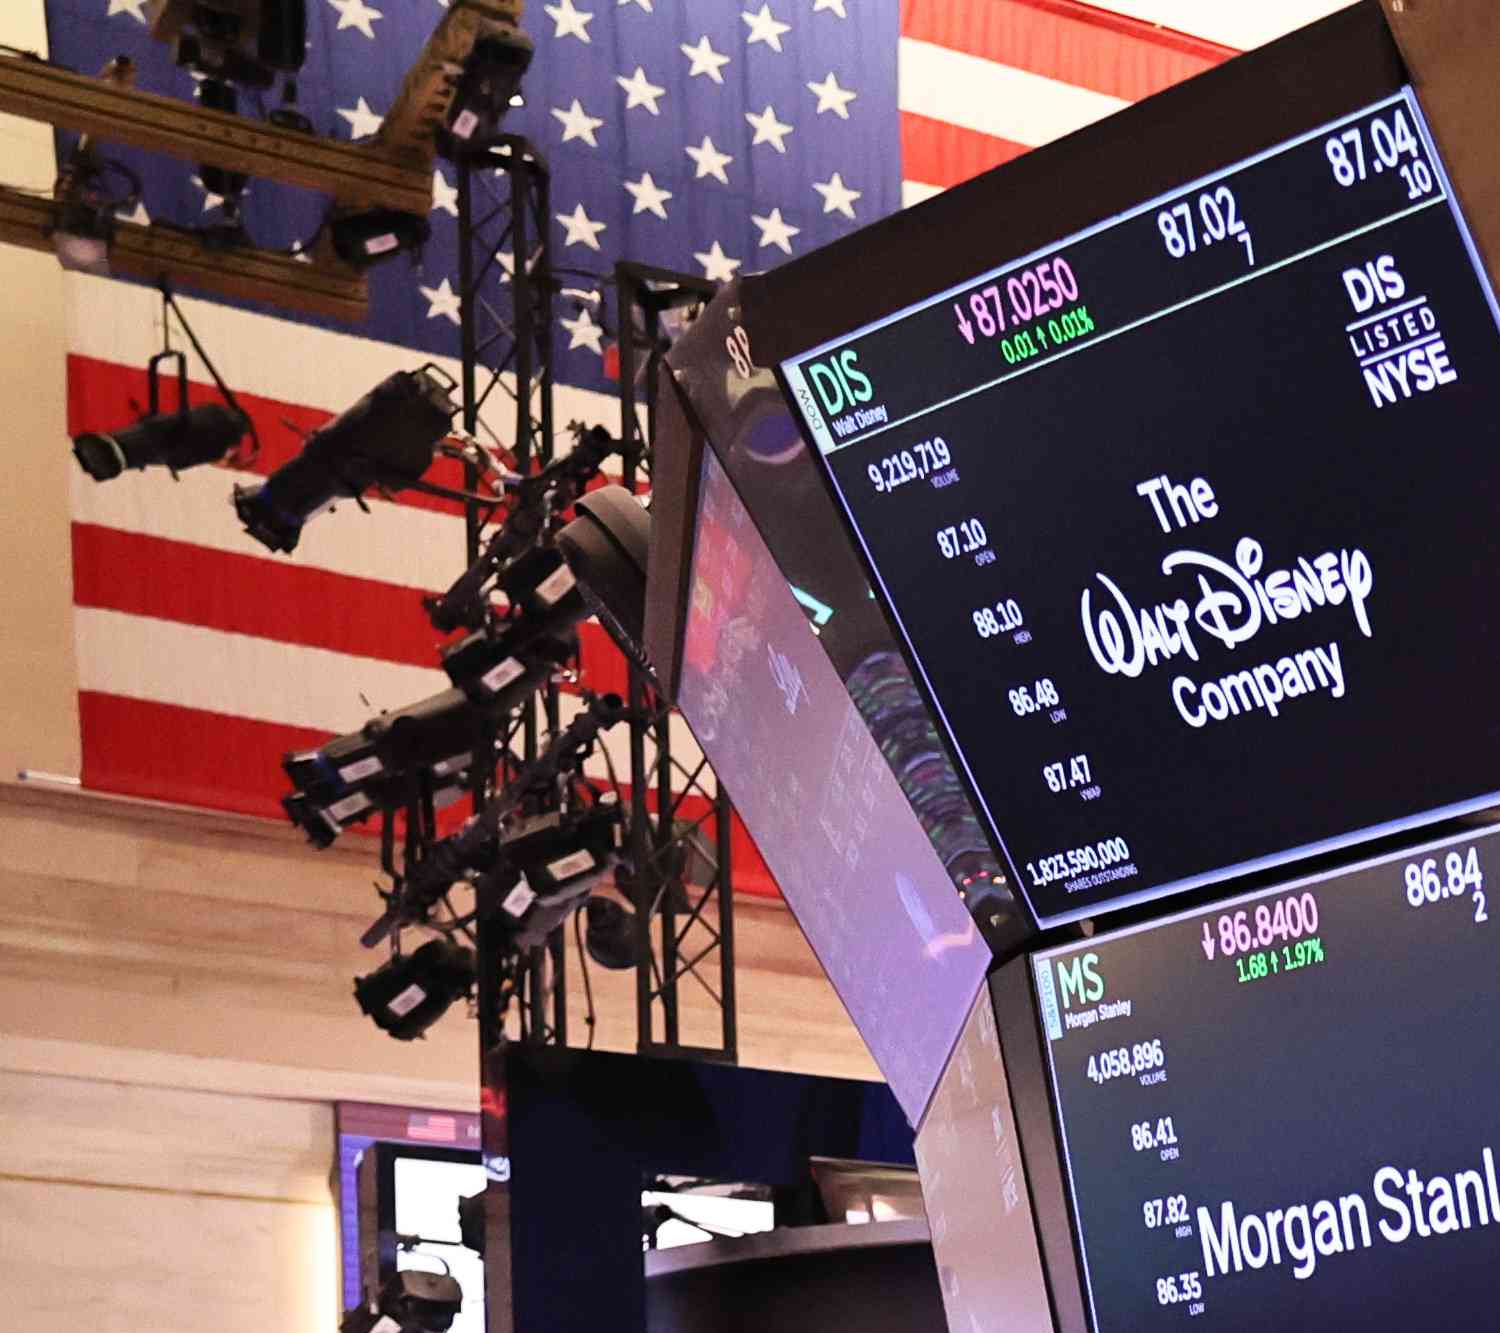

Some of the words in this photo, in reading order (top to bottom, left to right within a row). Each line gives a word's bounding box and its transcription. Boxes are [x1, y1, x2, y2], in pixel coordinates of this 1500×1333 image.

[1325, 110, 1417, 187] 87.04
[1157, 186, 1245, 258] 87.02
[969, 257, 1079, 339] 87.0250
[1343, 254, 1405, 312] DIS
[1002, 332, 1037, 364] 0.01
[1048, 306, 1095, 345] 0.01%
[1349, 307, 1436, 358] LISTED
[809, 349, 874, 414] DIS
[1363, 341, 1457, 408] NYSE
[832, 408, 861, 438] Walt
[857, 402, 889, 430] Disney
[868, 435, 951, 493] 9,219,719
[1137, 474, 1219, 533] The
[937, 518, 988, 560] 87.10
[972, 599, 1024, 640] 88.10
[1172, 642, 1346, 729] Company
[1026, 837, 1130, 887] 1,823,590,000
[1404, 847, 1483, 907] 86.84
[1218, 892, 1319, 956] 86.8400
[1057, 953, 1105, 1009] MS
[1237, 955, 1269, 983] 1.68
[1284, 939, 1324, 970] 1.97%
[1065, 1005, 1099, 1030] Morgan
[1099, 999, 1132, 1023] Stanley
[1086, 1040, 1164, 1084] 4,058,896
[1132, 1116, 1178, 1151] 86.41
[1196, 1190, 1371, 1280] Morgan
